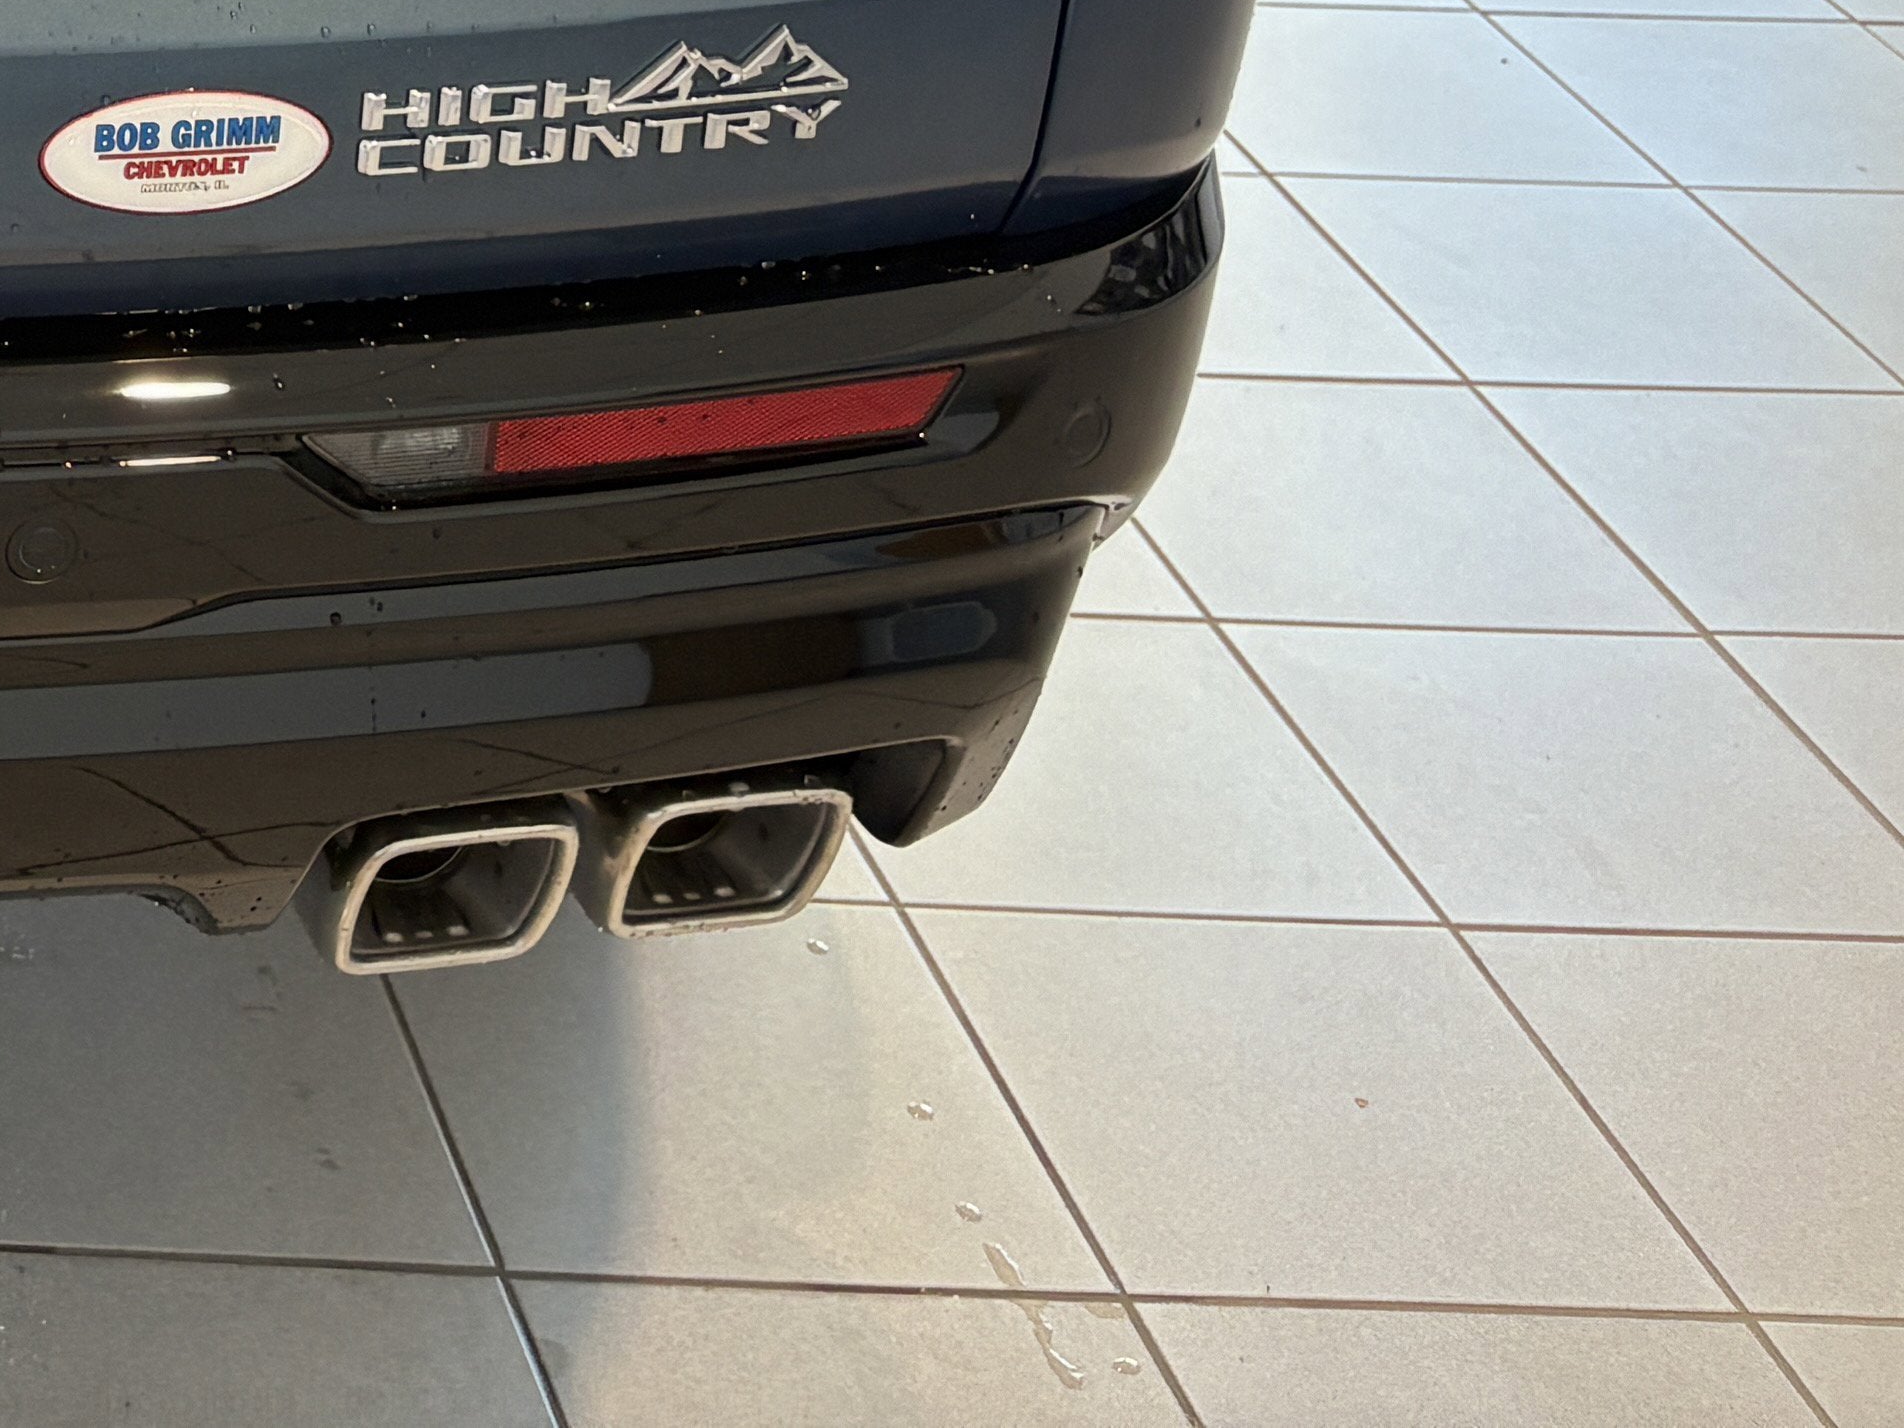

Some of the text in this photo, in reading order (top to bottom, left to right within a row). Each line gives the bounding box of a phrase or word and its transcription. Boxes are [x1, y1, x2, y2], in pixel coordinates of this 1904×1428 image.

[360, 76, 612, 132] HIGH
[94, 115, 283, 154] BOB GRIMM
[356, 99, 844, 178] COUNTRY
[123, 155, 250, 181] CHEVROLET
